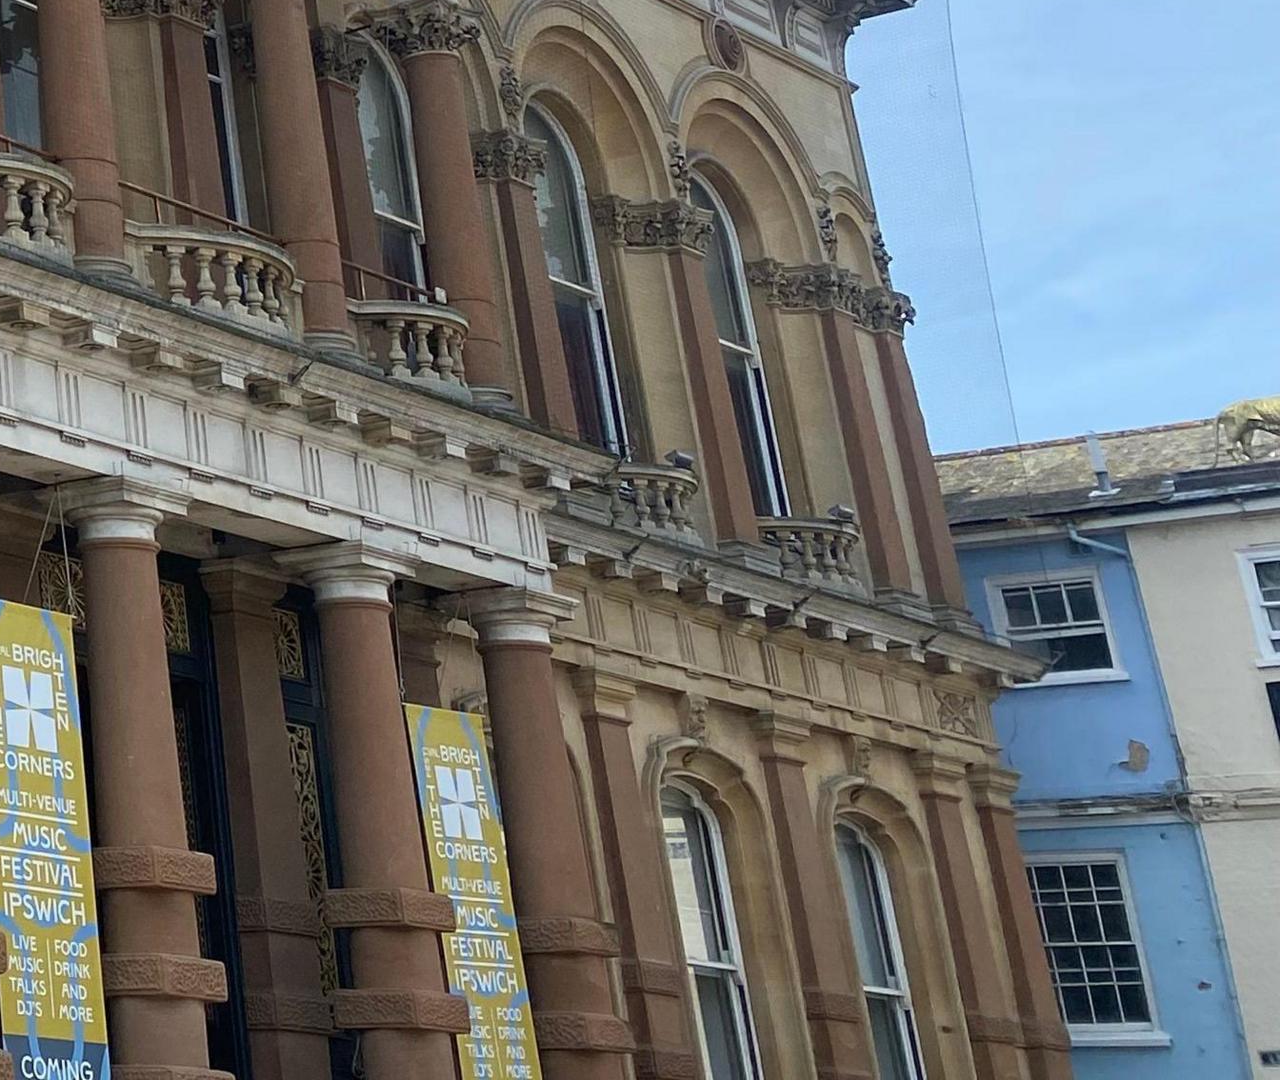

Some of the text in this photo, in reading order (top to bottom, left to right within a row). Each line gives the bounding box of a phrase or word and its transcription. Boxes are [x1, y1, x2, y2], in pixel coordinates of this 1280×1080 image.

[426, 784, 444, 838] THE
[12, 822, 67, 852] MUSIC
[435, 841, 498, 864] CORNERS
[0, 855, 83, 888] FESTIVAL
[441, 876, 503, 896] MULTI-VENUE
[3, 891, 87, 927] IPSWICH
[456, 905, 499, 929] MUSIC
[11, 933, 37, 952] LIVE
[53, 939, 88, 957] FOOD
[450, 936, 513, 960] FESTIVAL
[8, 955, 45, 974] MUSIC
[53, 961, 91, 979] DRINK
[8, 976, 47, 996] TALKS
[454, 968, 519, 994] IPSWICH
[61, 983, 88, 1000] AND
[16, 1000, 43, 1017] DJ'S
[59, 1004, 95, 1023] MORE
[496, 1007, 522, 1022] FOOD
[21, 1055, 94, 1080] COMING
[505, 1064, 533, 1080] MORE
